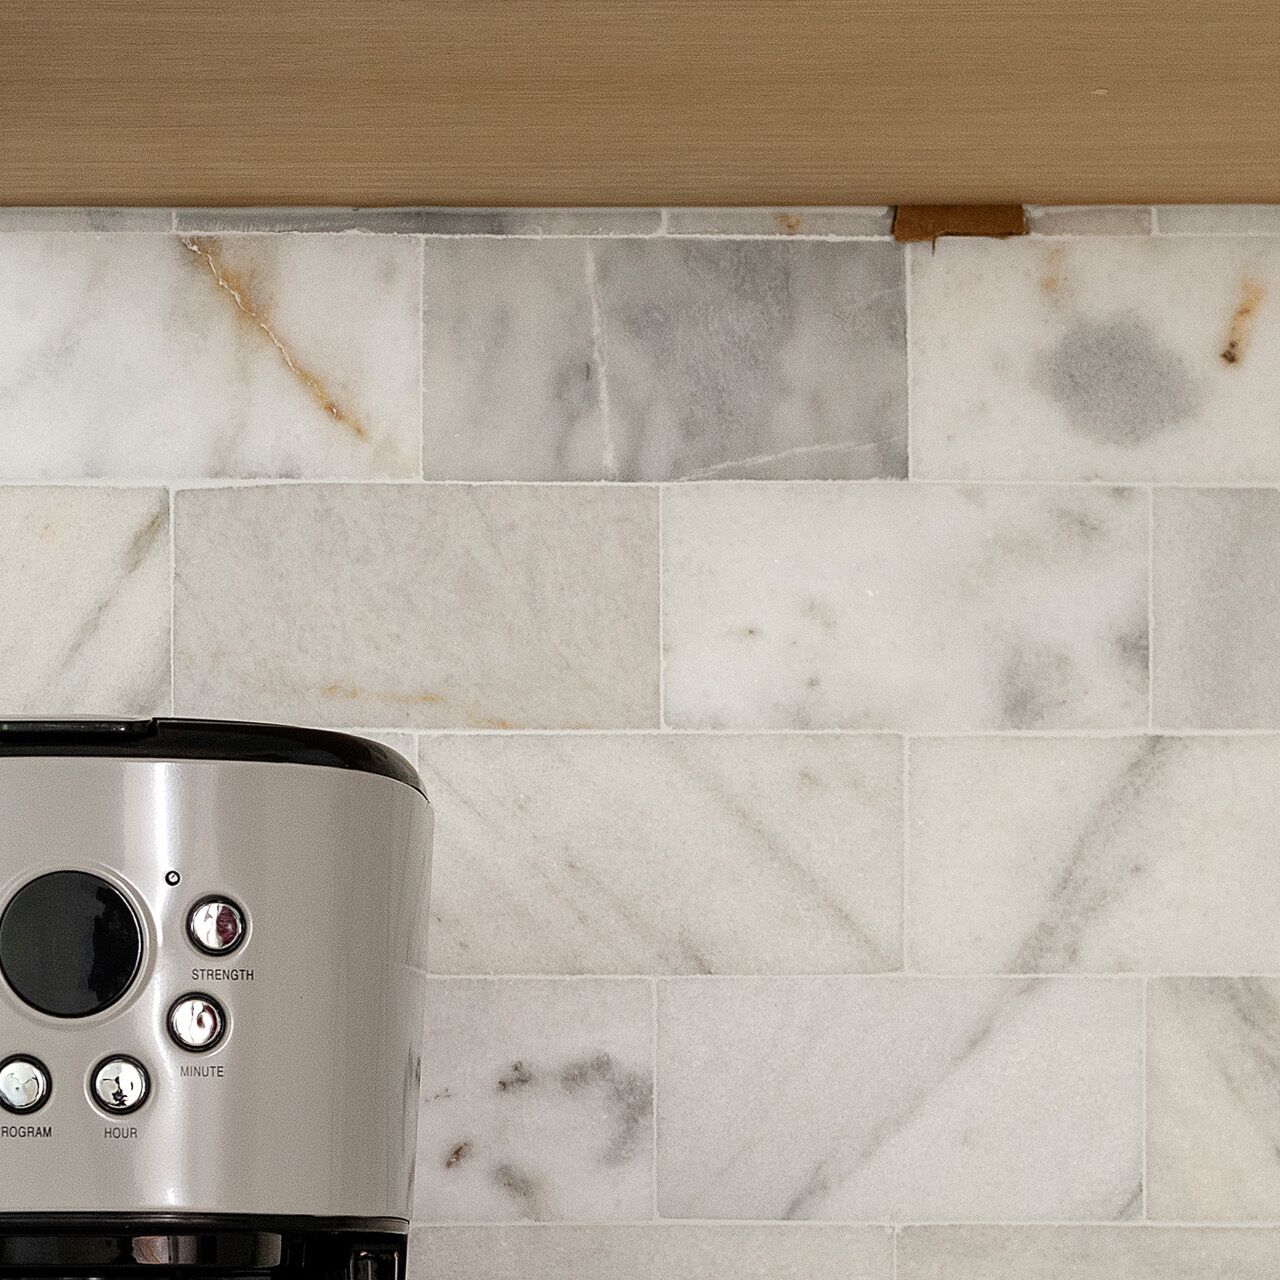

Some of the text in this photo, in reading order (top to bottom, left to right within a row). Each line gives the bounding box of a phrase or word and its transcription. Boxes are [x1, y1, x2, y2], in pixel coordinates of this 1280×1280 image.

[191, 968, 254, 981] STRENGTH
[180, 1066, 224, 1078] MINUTE
[104, 1127, 138, 1139] HOUR
